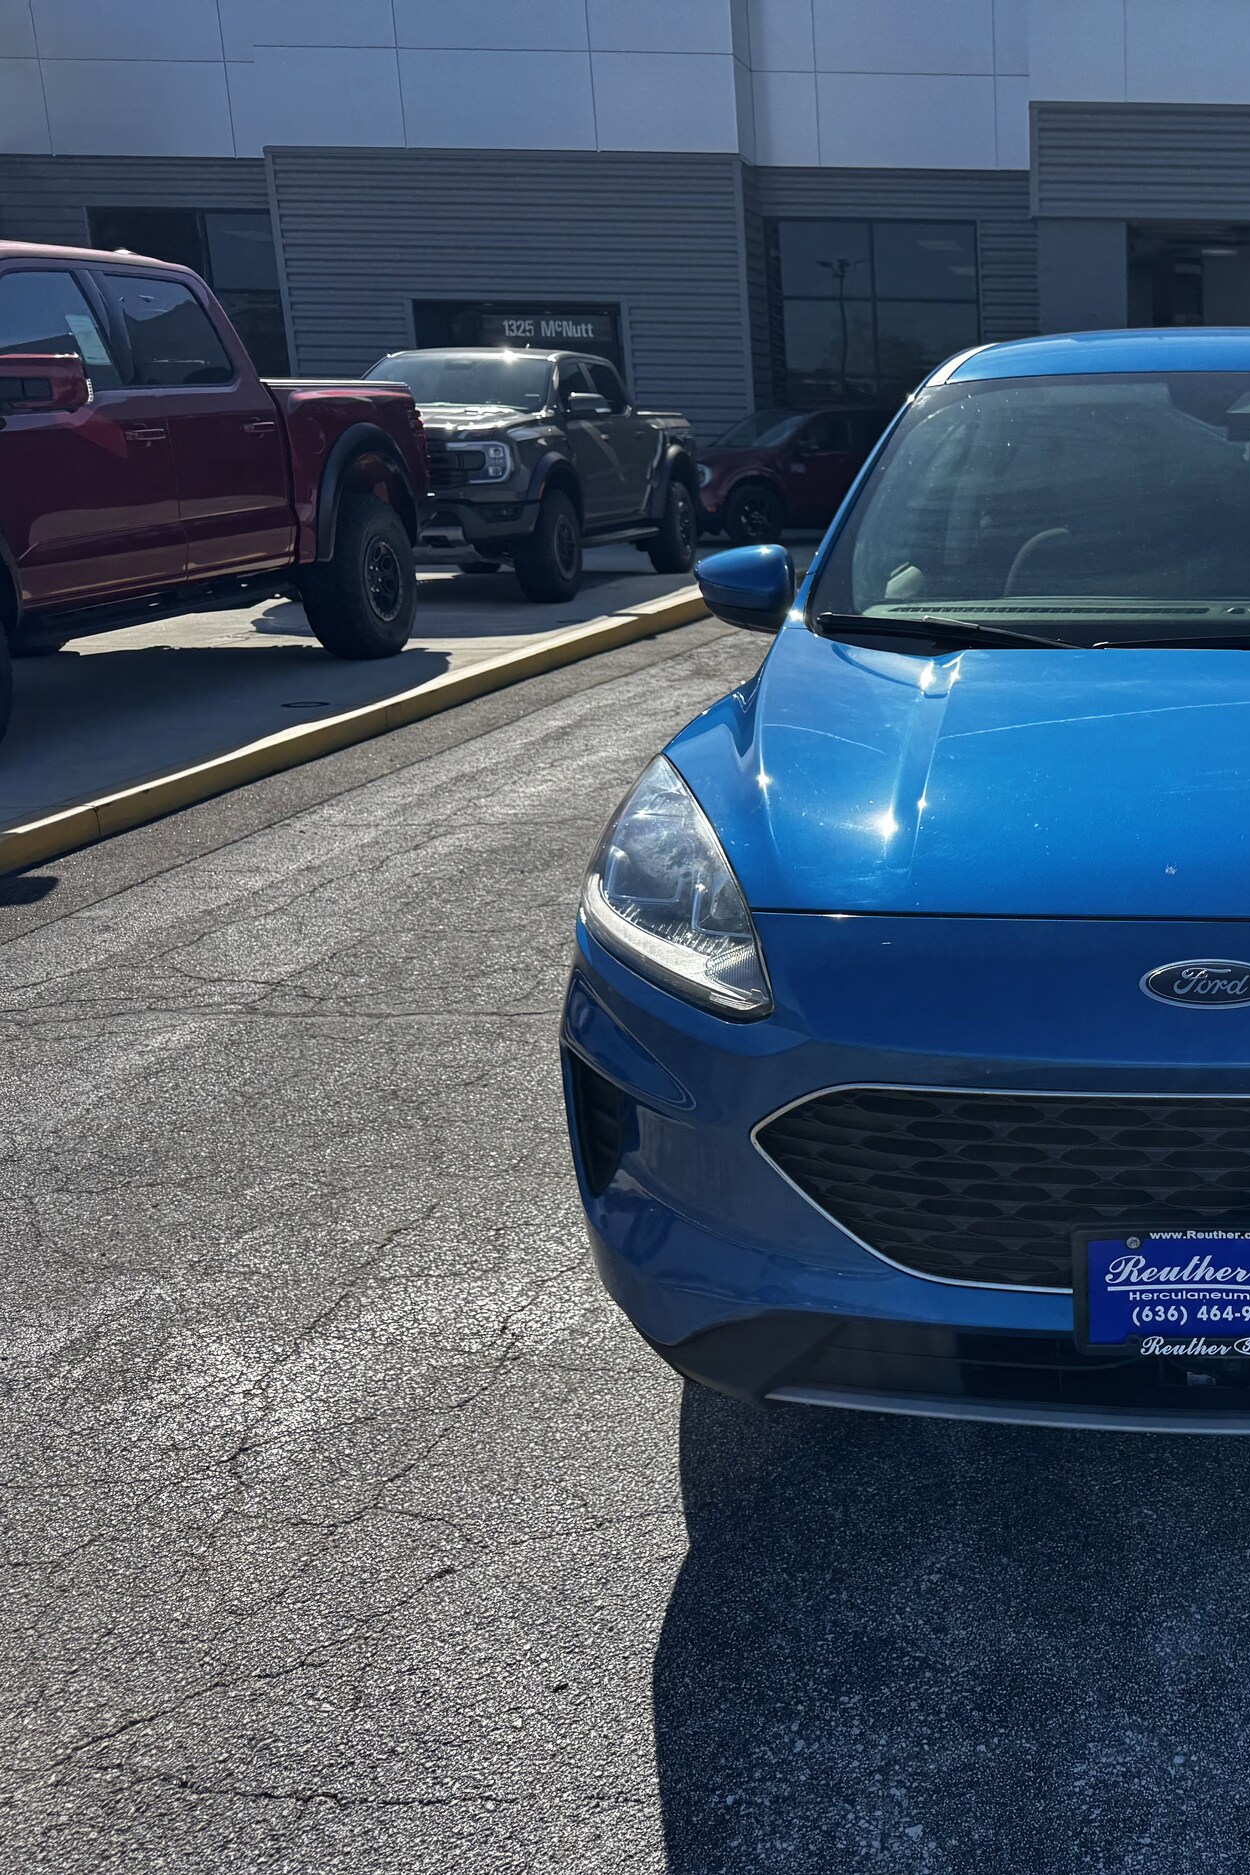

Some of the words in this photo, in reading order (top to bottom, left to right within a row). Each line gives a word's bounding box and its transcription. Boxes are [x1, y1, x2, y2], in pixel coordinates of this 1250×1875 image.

[502, 319, 534, 337] 1325
[541, 319, 594, 338] McNutt
[1173, 967, 1249, 995] Ford
[1132, 1305, 1188, 1327] (636)
[1140, 1335, 1232, 1356] Reuther
